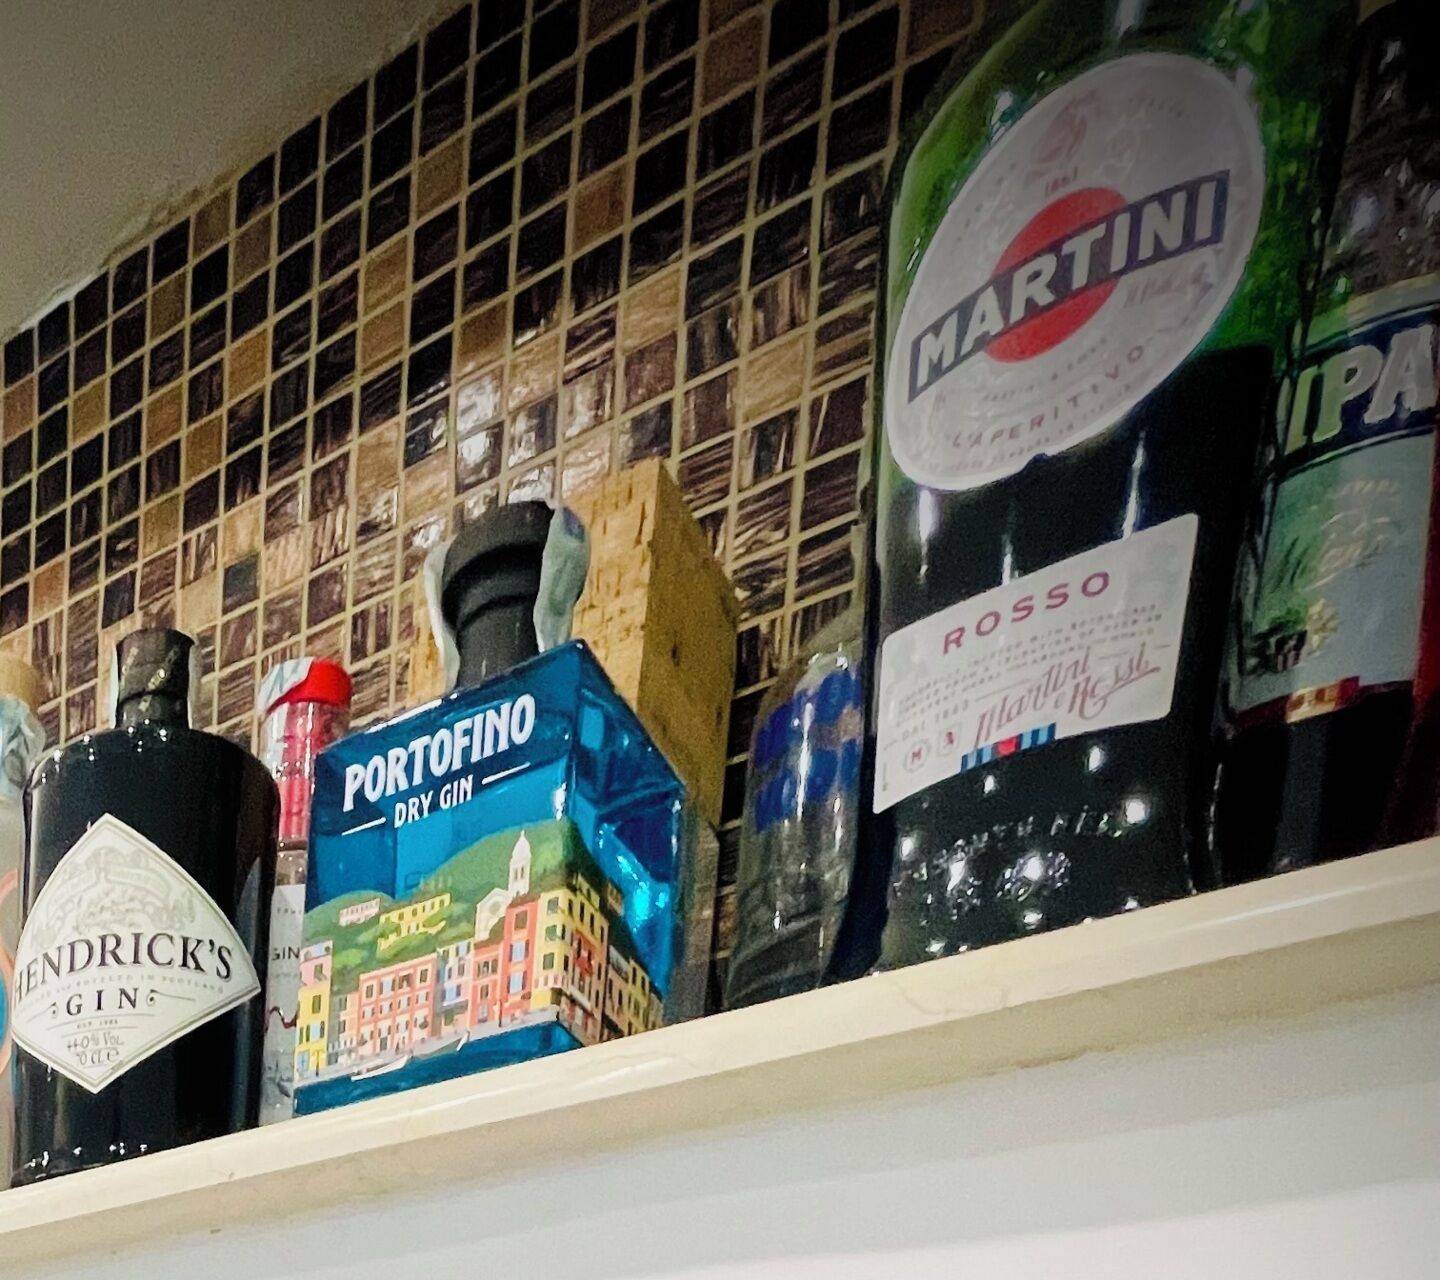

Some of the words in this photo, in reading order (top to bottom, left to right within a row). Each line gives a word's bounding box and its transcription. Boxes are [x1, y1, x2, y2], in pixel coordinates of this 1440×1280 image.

[916, 178, 1220, 389] MARTINI
[943, 571, 1110, 655] ROSSO
[343, 694, 536, 812] PORTOFINO
[394, 791, 433, 829] DRY
[439, 774, 474, 811] GIN
[15, 932, 232, 1006] HENDRICK'S
[66, 987, 140, 1016] GIN
